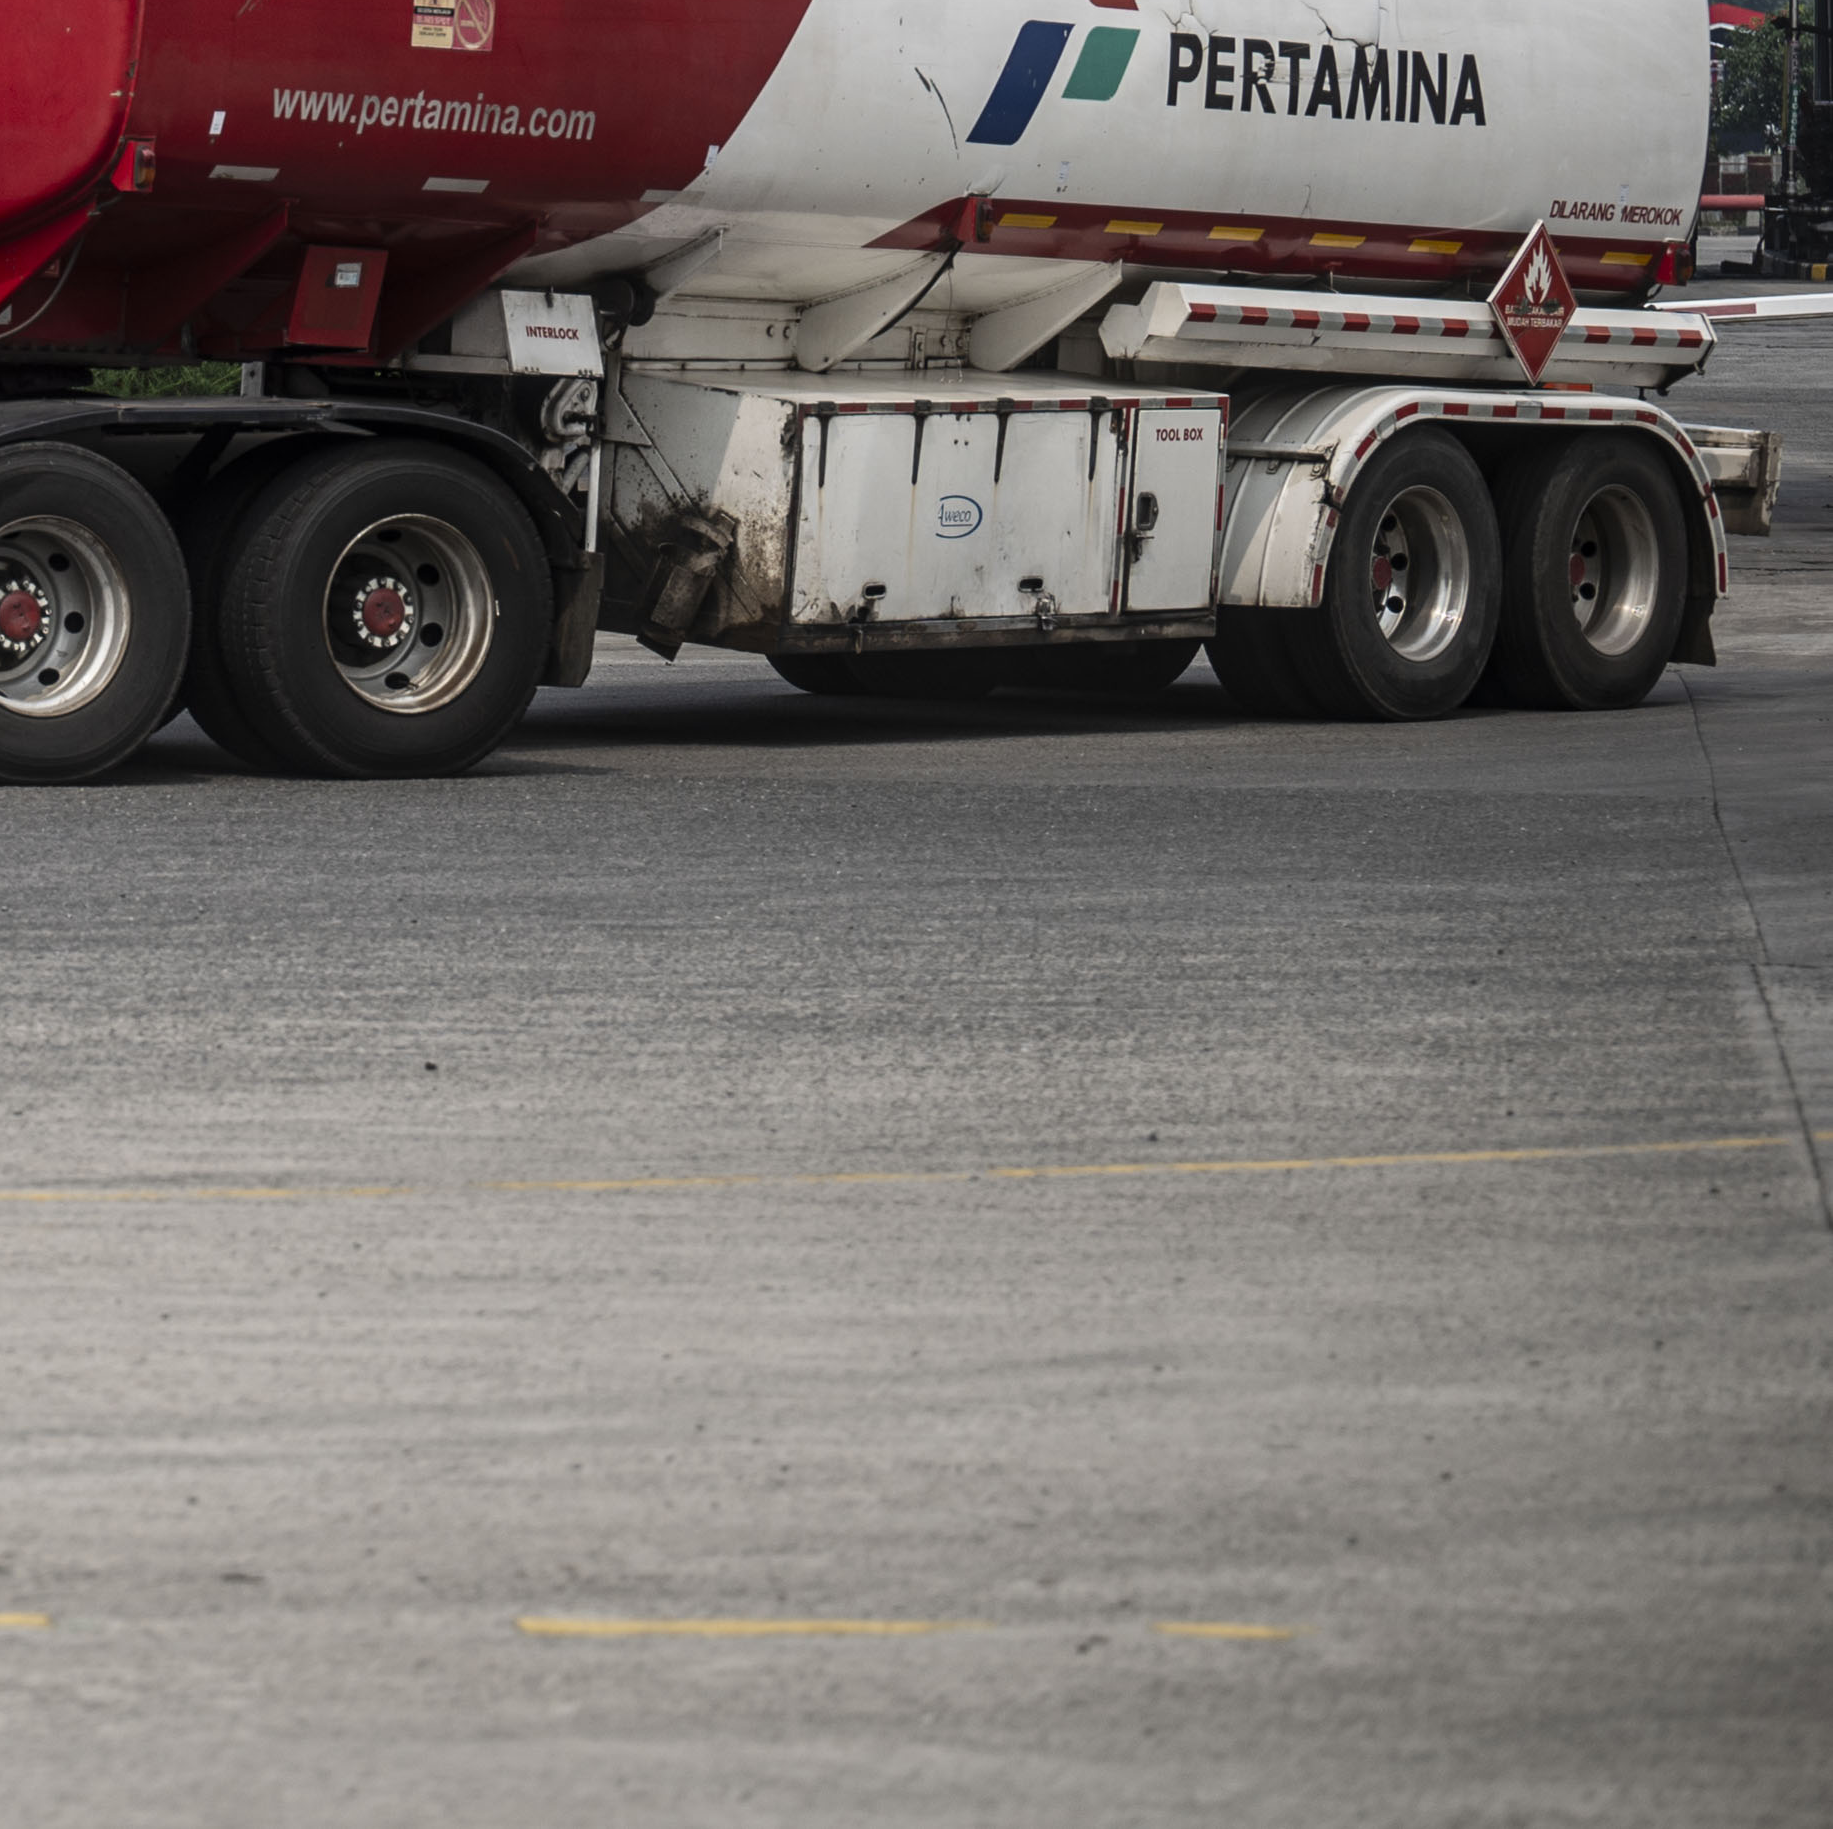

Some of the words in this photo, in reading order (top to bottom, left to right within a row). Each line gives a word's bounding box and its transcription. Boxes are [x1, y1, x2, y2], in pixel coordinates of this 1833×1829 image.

[1166, 31, 1487, 127] PERTAMINA
[272, 87, 596, 141] www.pertamina.com
[1549, 200, 1615, 222] DILARANG
[1620, 206, 1683, 227] MEROKOK
[525, 325, 580, 341] INTERLOCK
[1155, 427, 1181, 442] TOOL
[1183, 427, 1204, 442] BOX
